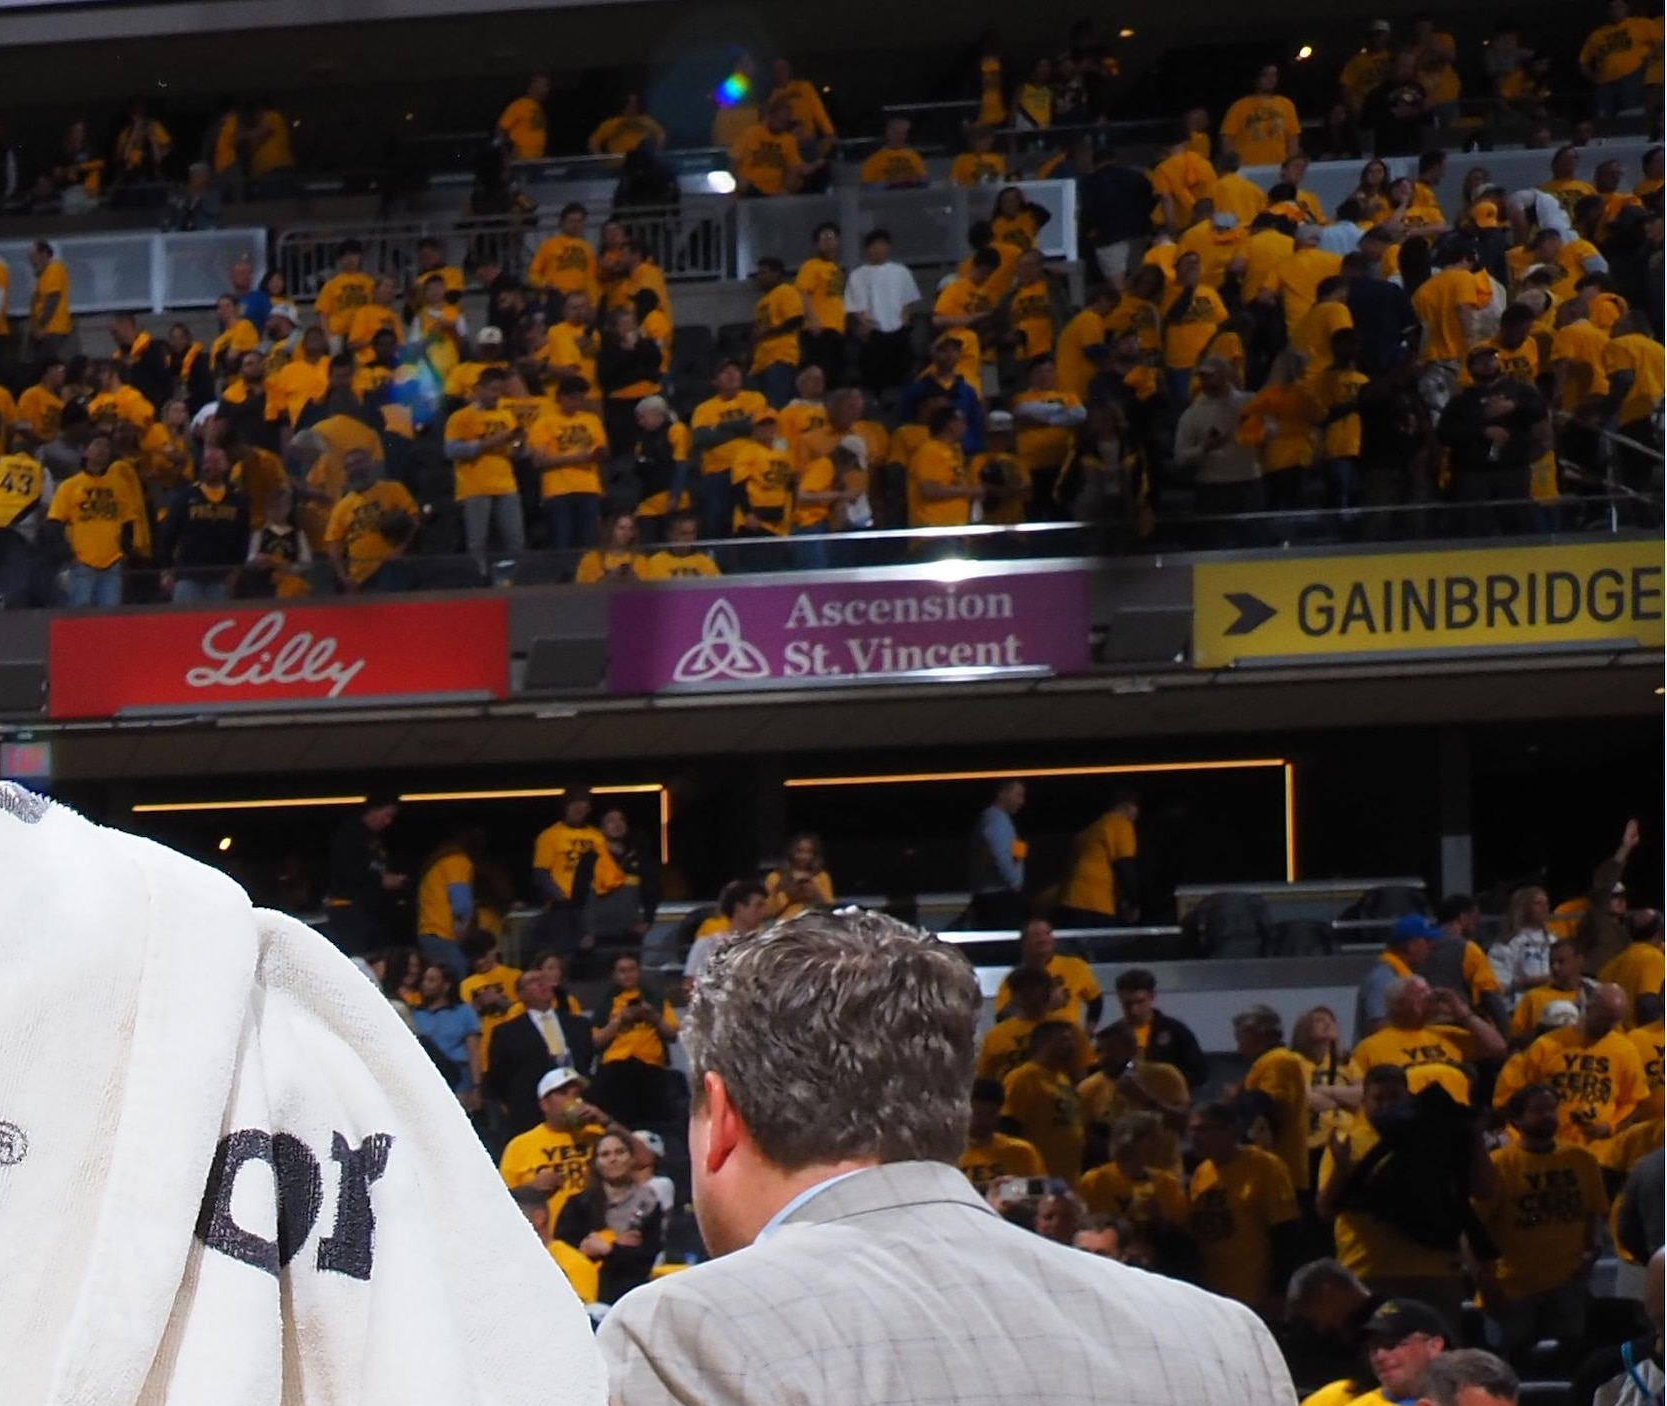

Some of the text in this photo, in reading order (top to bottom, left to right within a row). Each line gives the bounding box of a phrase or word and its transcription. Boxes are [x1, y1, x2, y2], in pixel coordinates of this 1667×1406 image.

[0, 471, 33, 496] 43
[783, 586, 1013, 629] Ascension
[1297, 566, 1662, 637] GAINBRIDGE
[185, 611, 366, 696] Lilly
[783, 633, 1023, 677] St. Vincent
[1403, 1044, 1447, 1060] YES
[1563, 1054, 1609, 1073] YES
